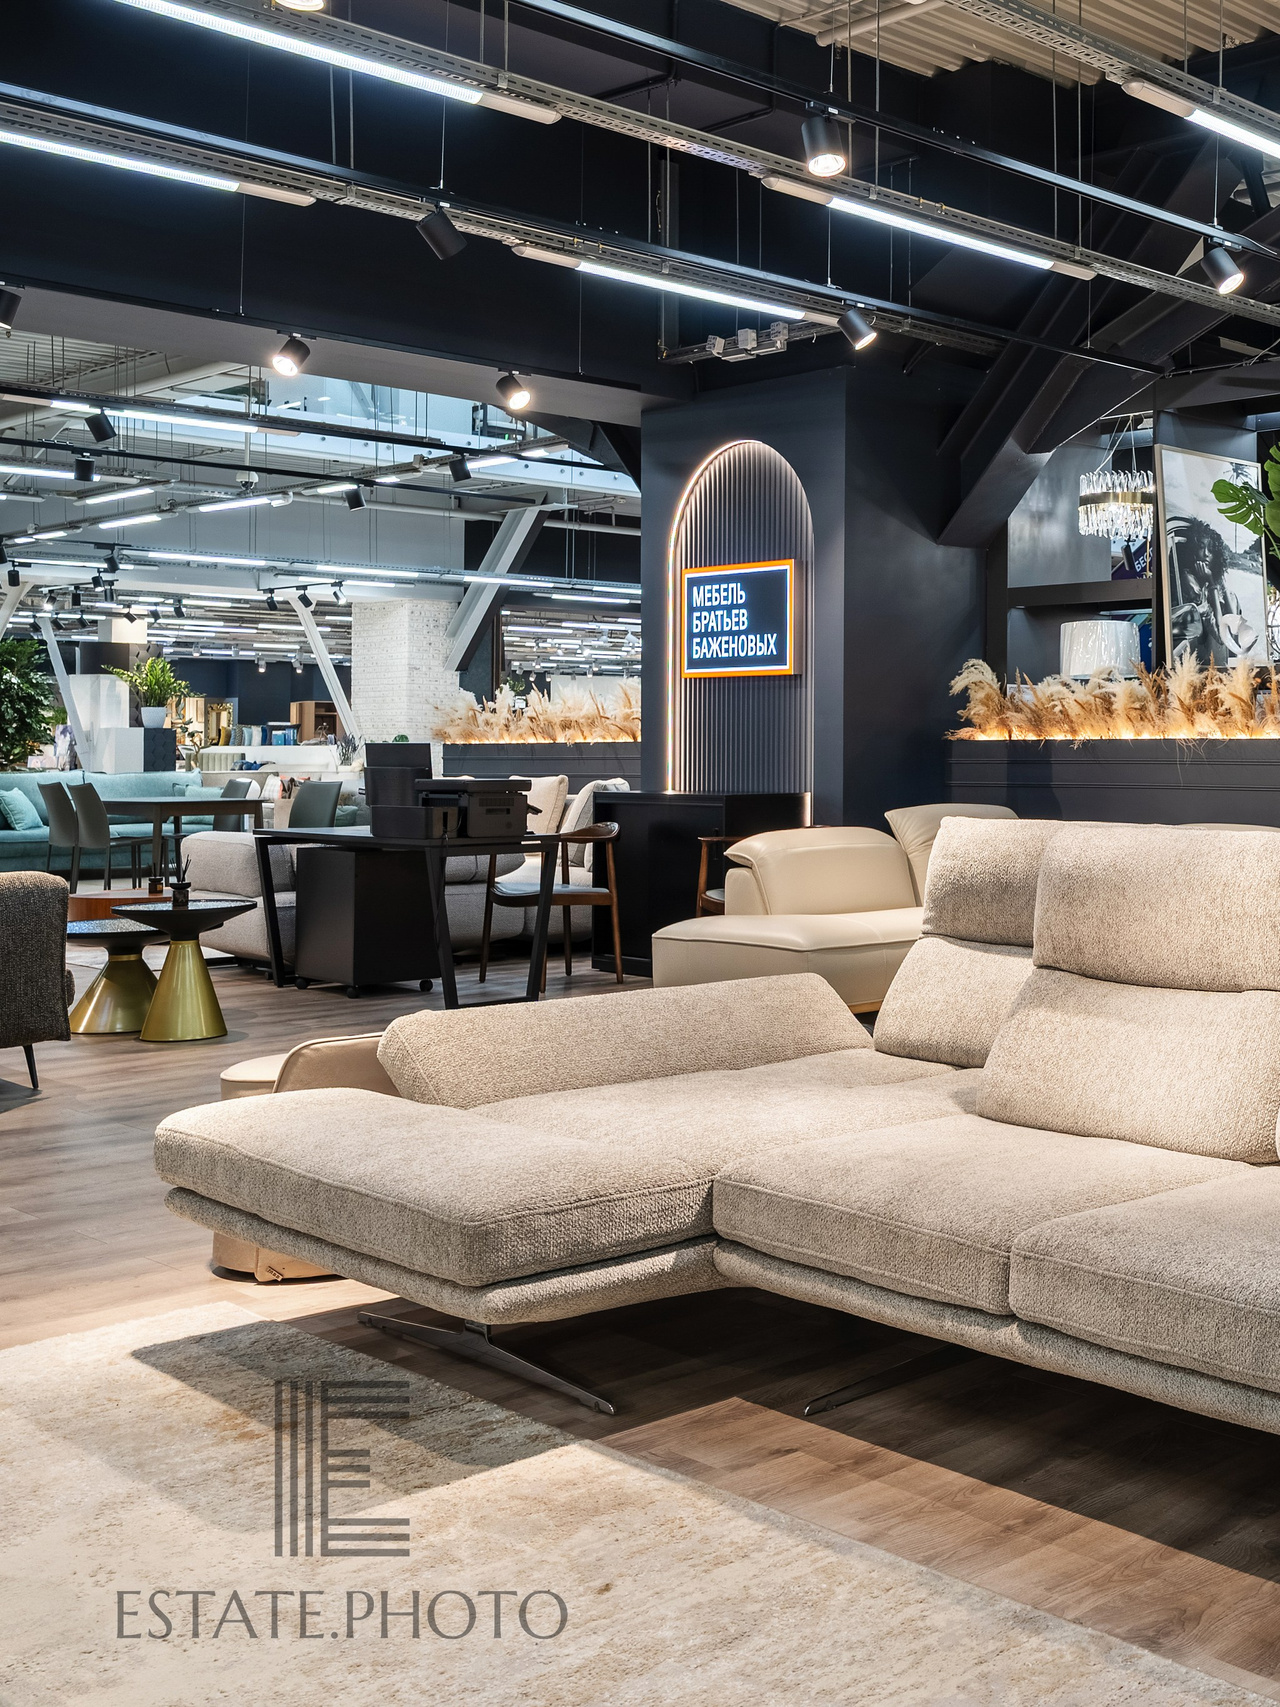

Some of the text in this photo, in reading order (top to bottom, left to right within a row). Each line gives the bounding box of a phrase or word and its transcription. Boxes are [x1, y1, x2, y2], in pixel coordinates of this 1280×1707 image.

[692, 582, 746, 607] МЕБЕЛЬ
[692, 608, 748, 633] БРАТЬЕВ
[692, 633, 777, 659] БАЖЕНОВЫХ
